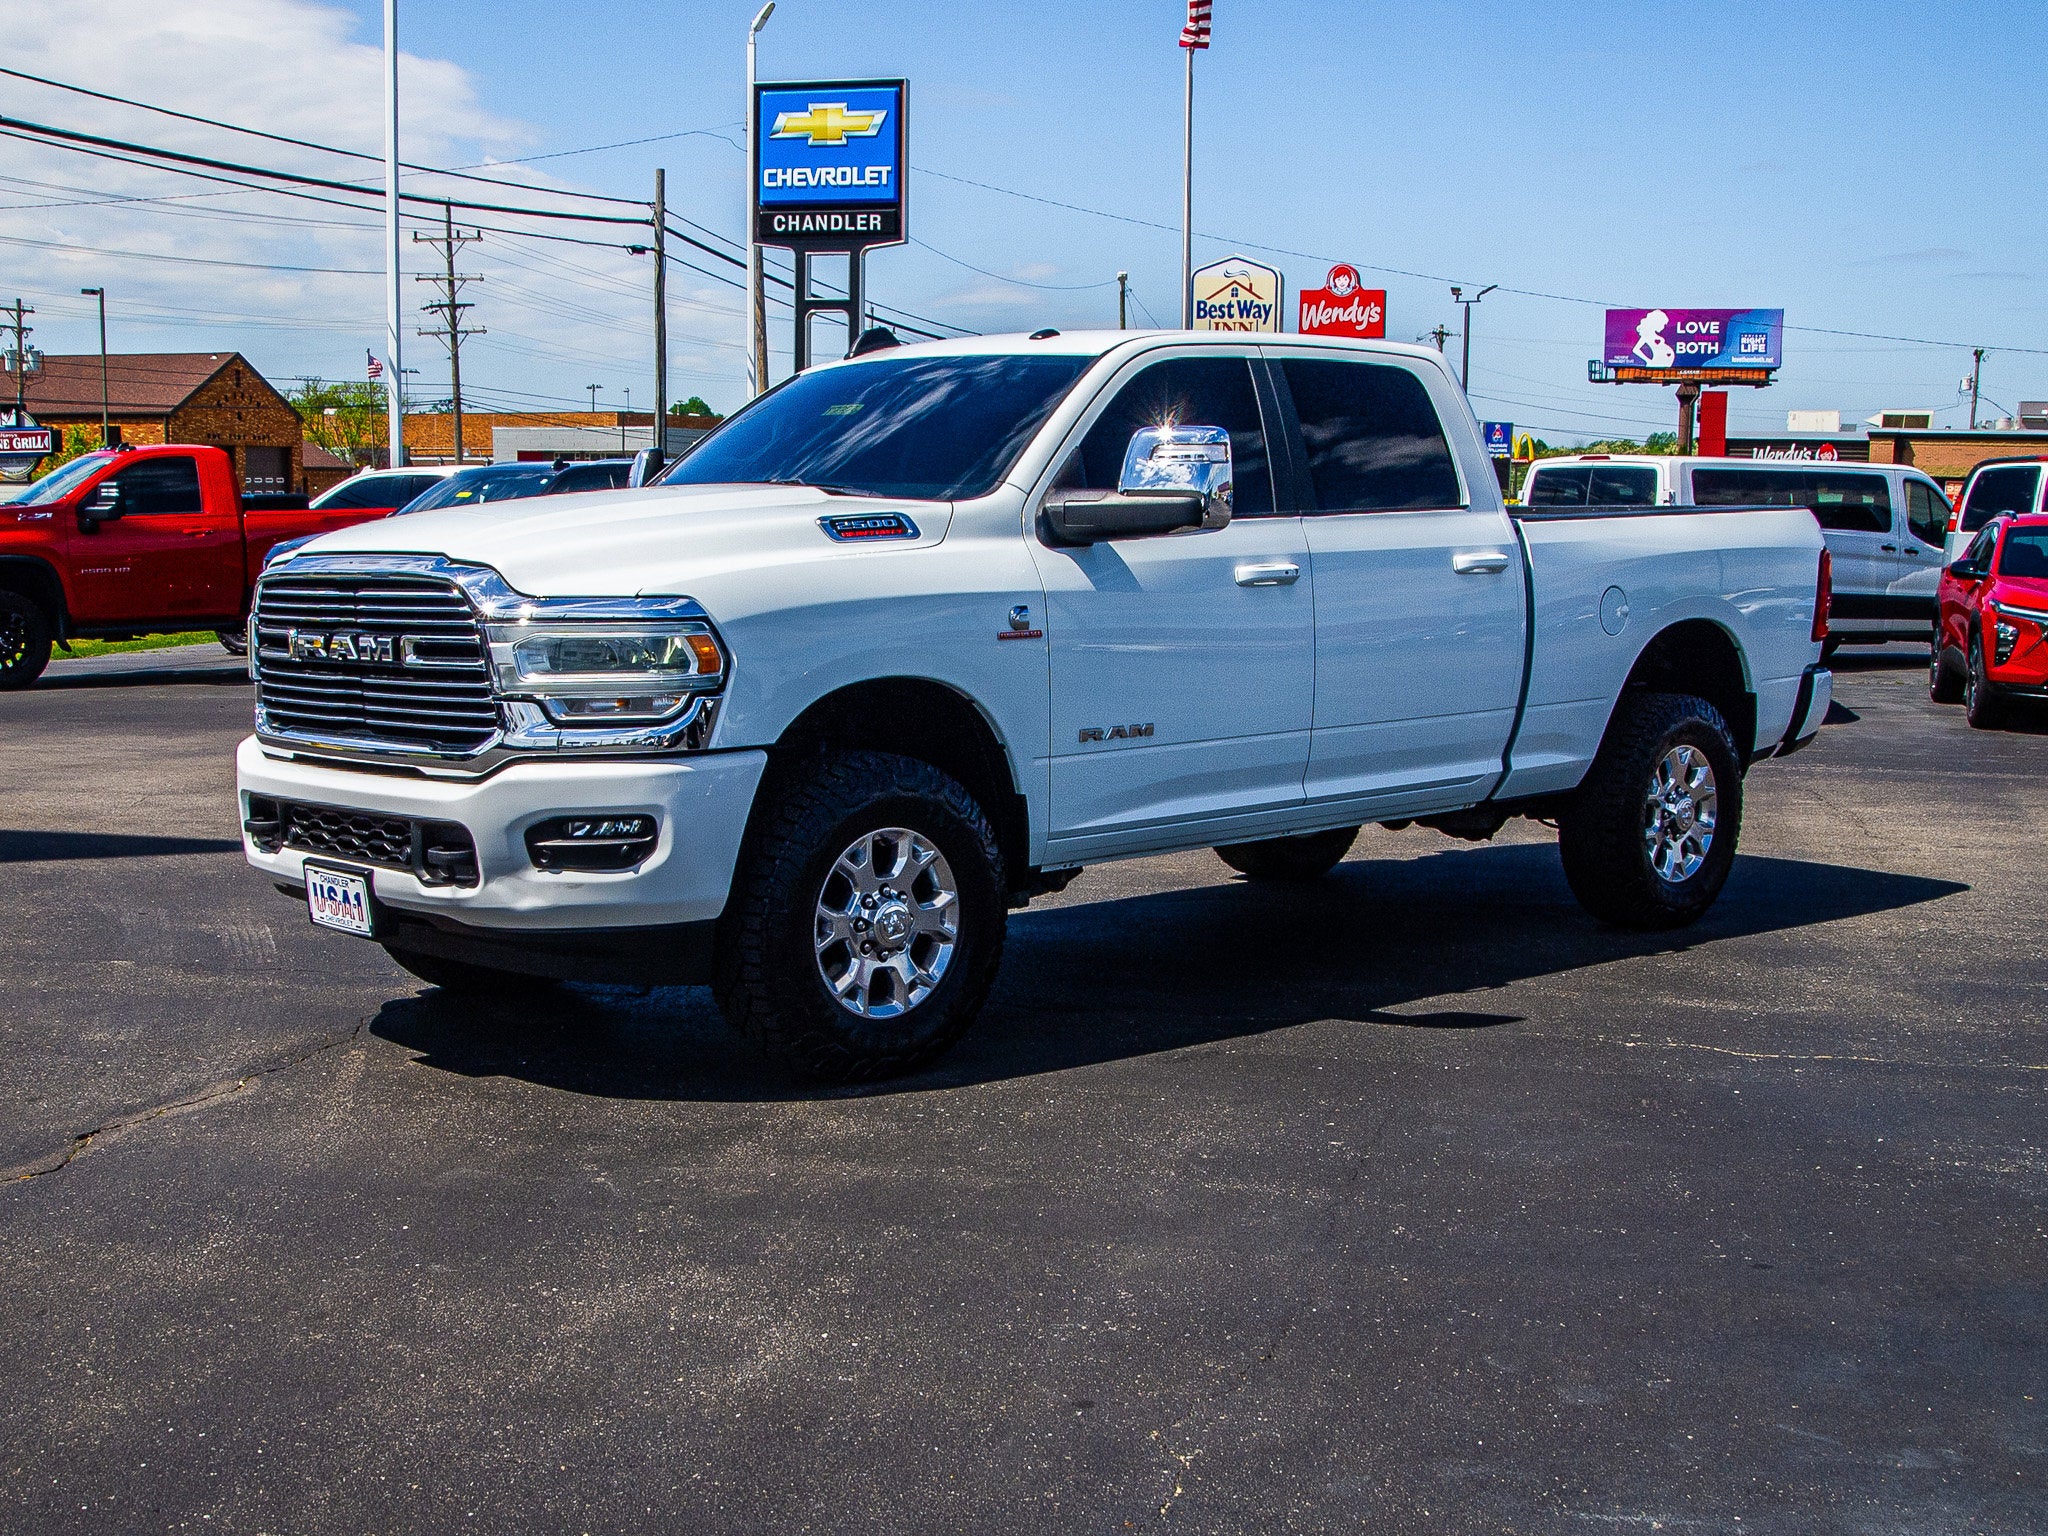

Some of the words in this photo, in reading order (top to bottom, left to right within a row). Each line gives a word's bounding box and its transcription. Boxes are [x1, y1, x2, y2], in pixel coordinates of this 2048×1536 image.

[763, 165, 892, 187] CHEVROLET
[773, 213, 882, 232] CHANDLER
[1196, 299, 1235, 320] Best
[1236, 299, 1273, 326] Way
[1302, 296, 1382, 332] Wendy's
[1213, 321, 1254, 332] INN
[1676, 321, 1720, 335] LOVE
[1675, 341, 1719, 355] BOTH
[1740, 343, 1767, 353] LIFE
[12, 435, 45, 450] GRILL
[1752, 442, 1812, 461] Wendy's
[834, 519, 899, 530] 2500
[297, 632, 397, 662] RAM
[1079, 722, 1155, 743] RAM
[319, 874, 350, 889] CHANDLER
